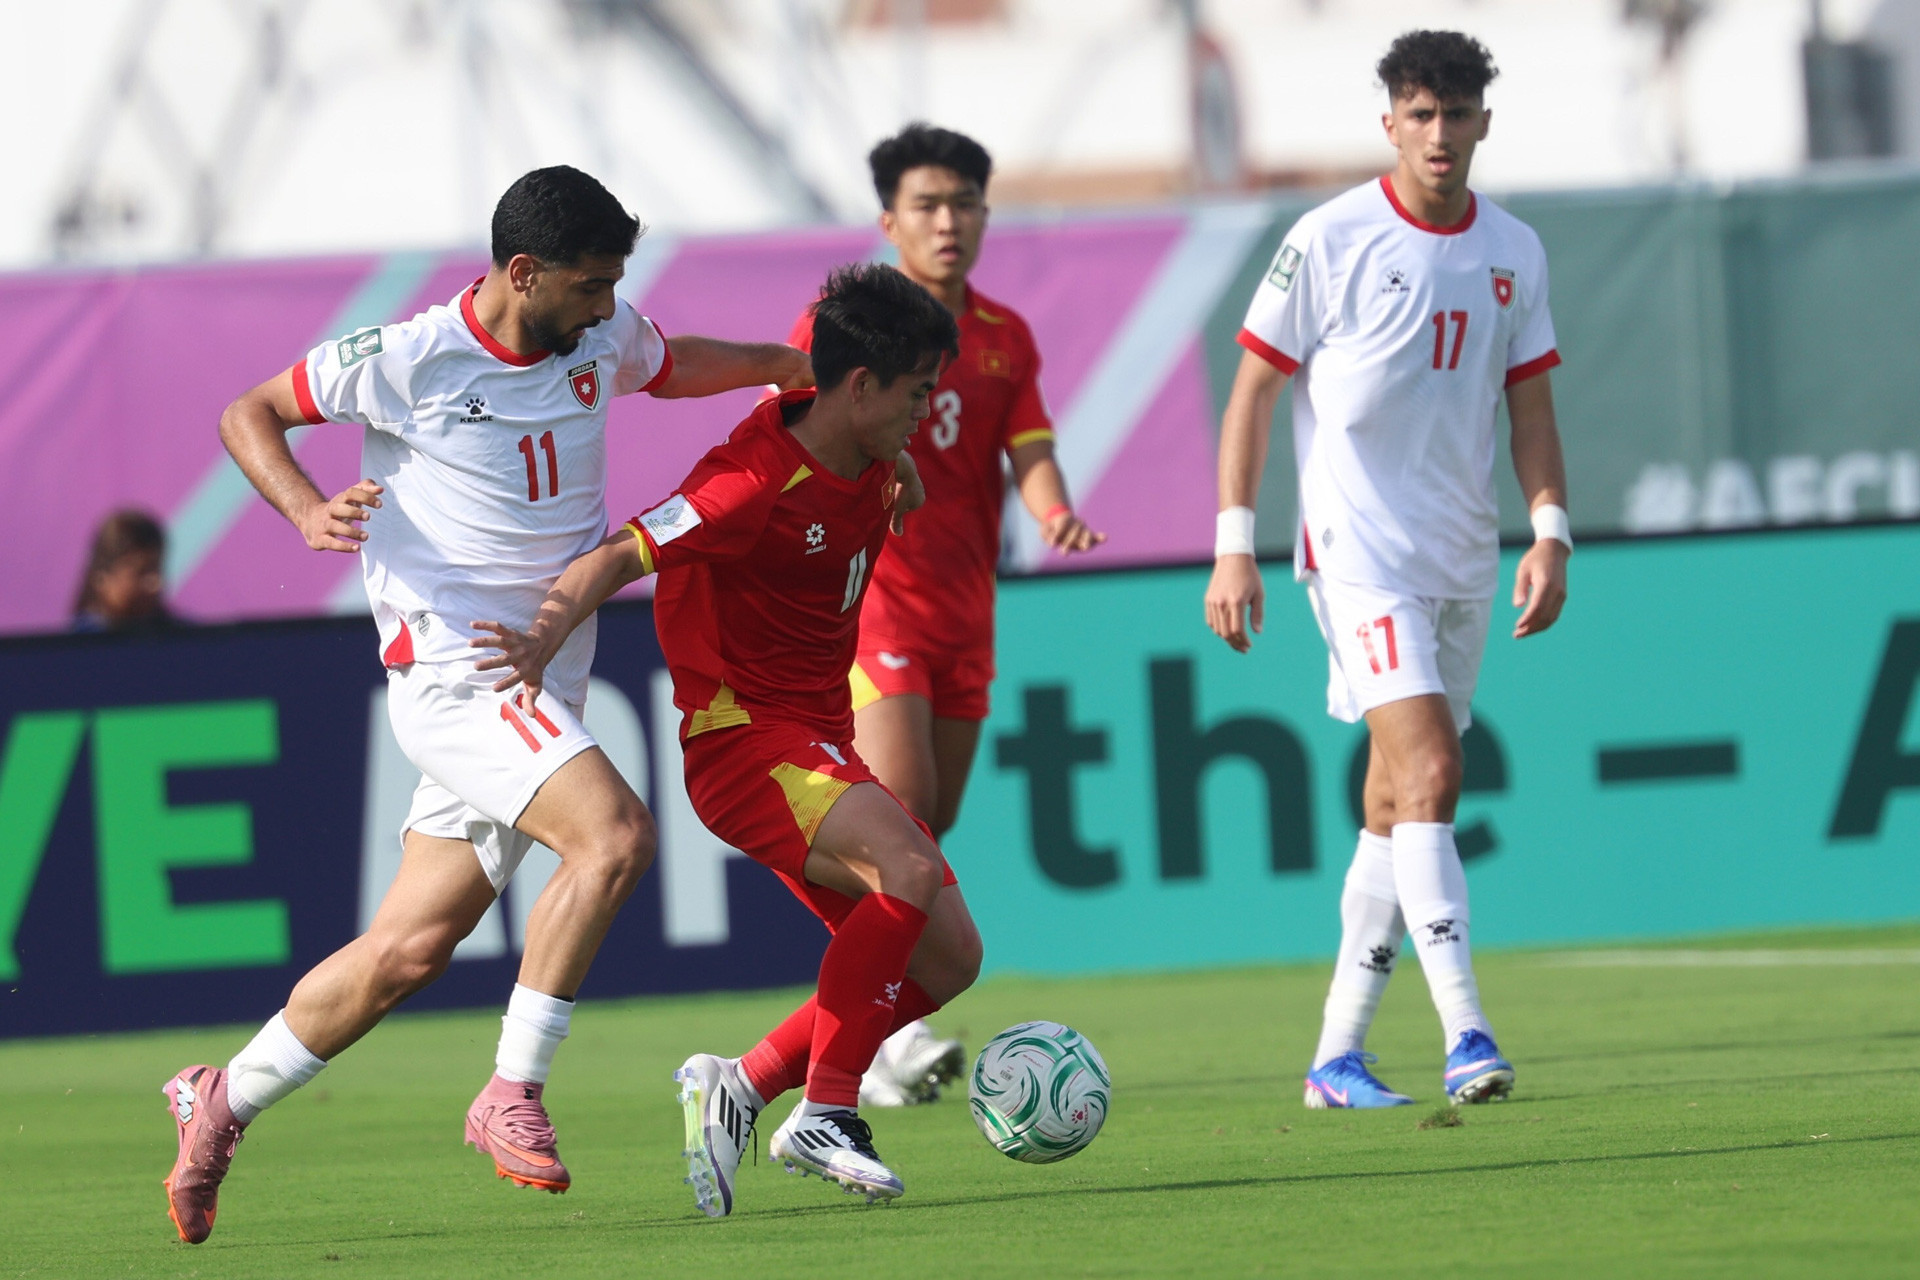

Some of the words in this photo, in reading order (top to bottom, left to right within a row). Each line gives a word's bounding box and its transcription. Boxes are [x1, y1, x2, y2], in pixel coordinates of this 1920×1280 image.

[570, 361, 594, 376] JORDAN
[1432, 309, 1469, 371] 17
[460, 415, 494, 424] KELME
[931, 389, 962, 450] 3
[518, 430, 559, 502] 11
[841, 546, 867, 614] 11
[1356, 615, 1399, 675] 17
[500, 693, 562, 754] 11
